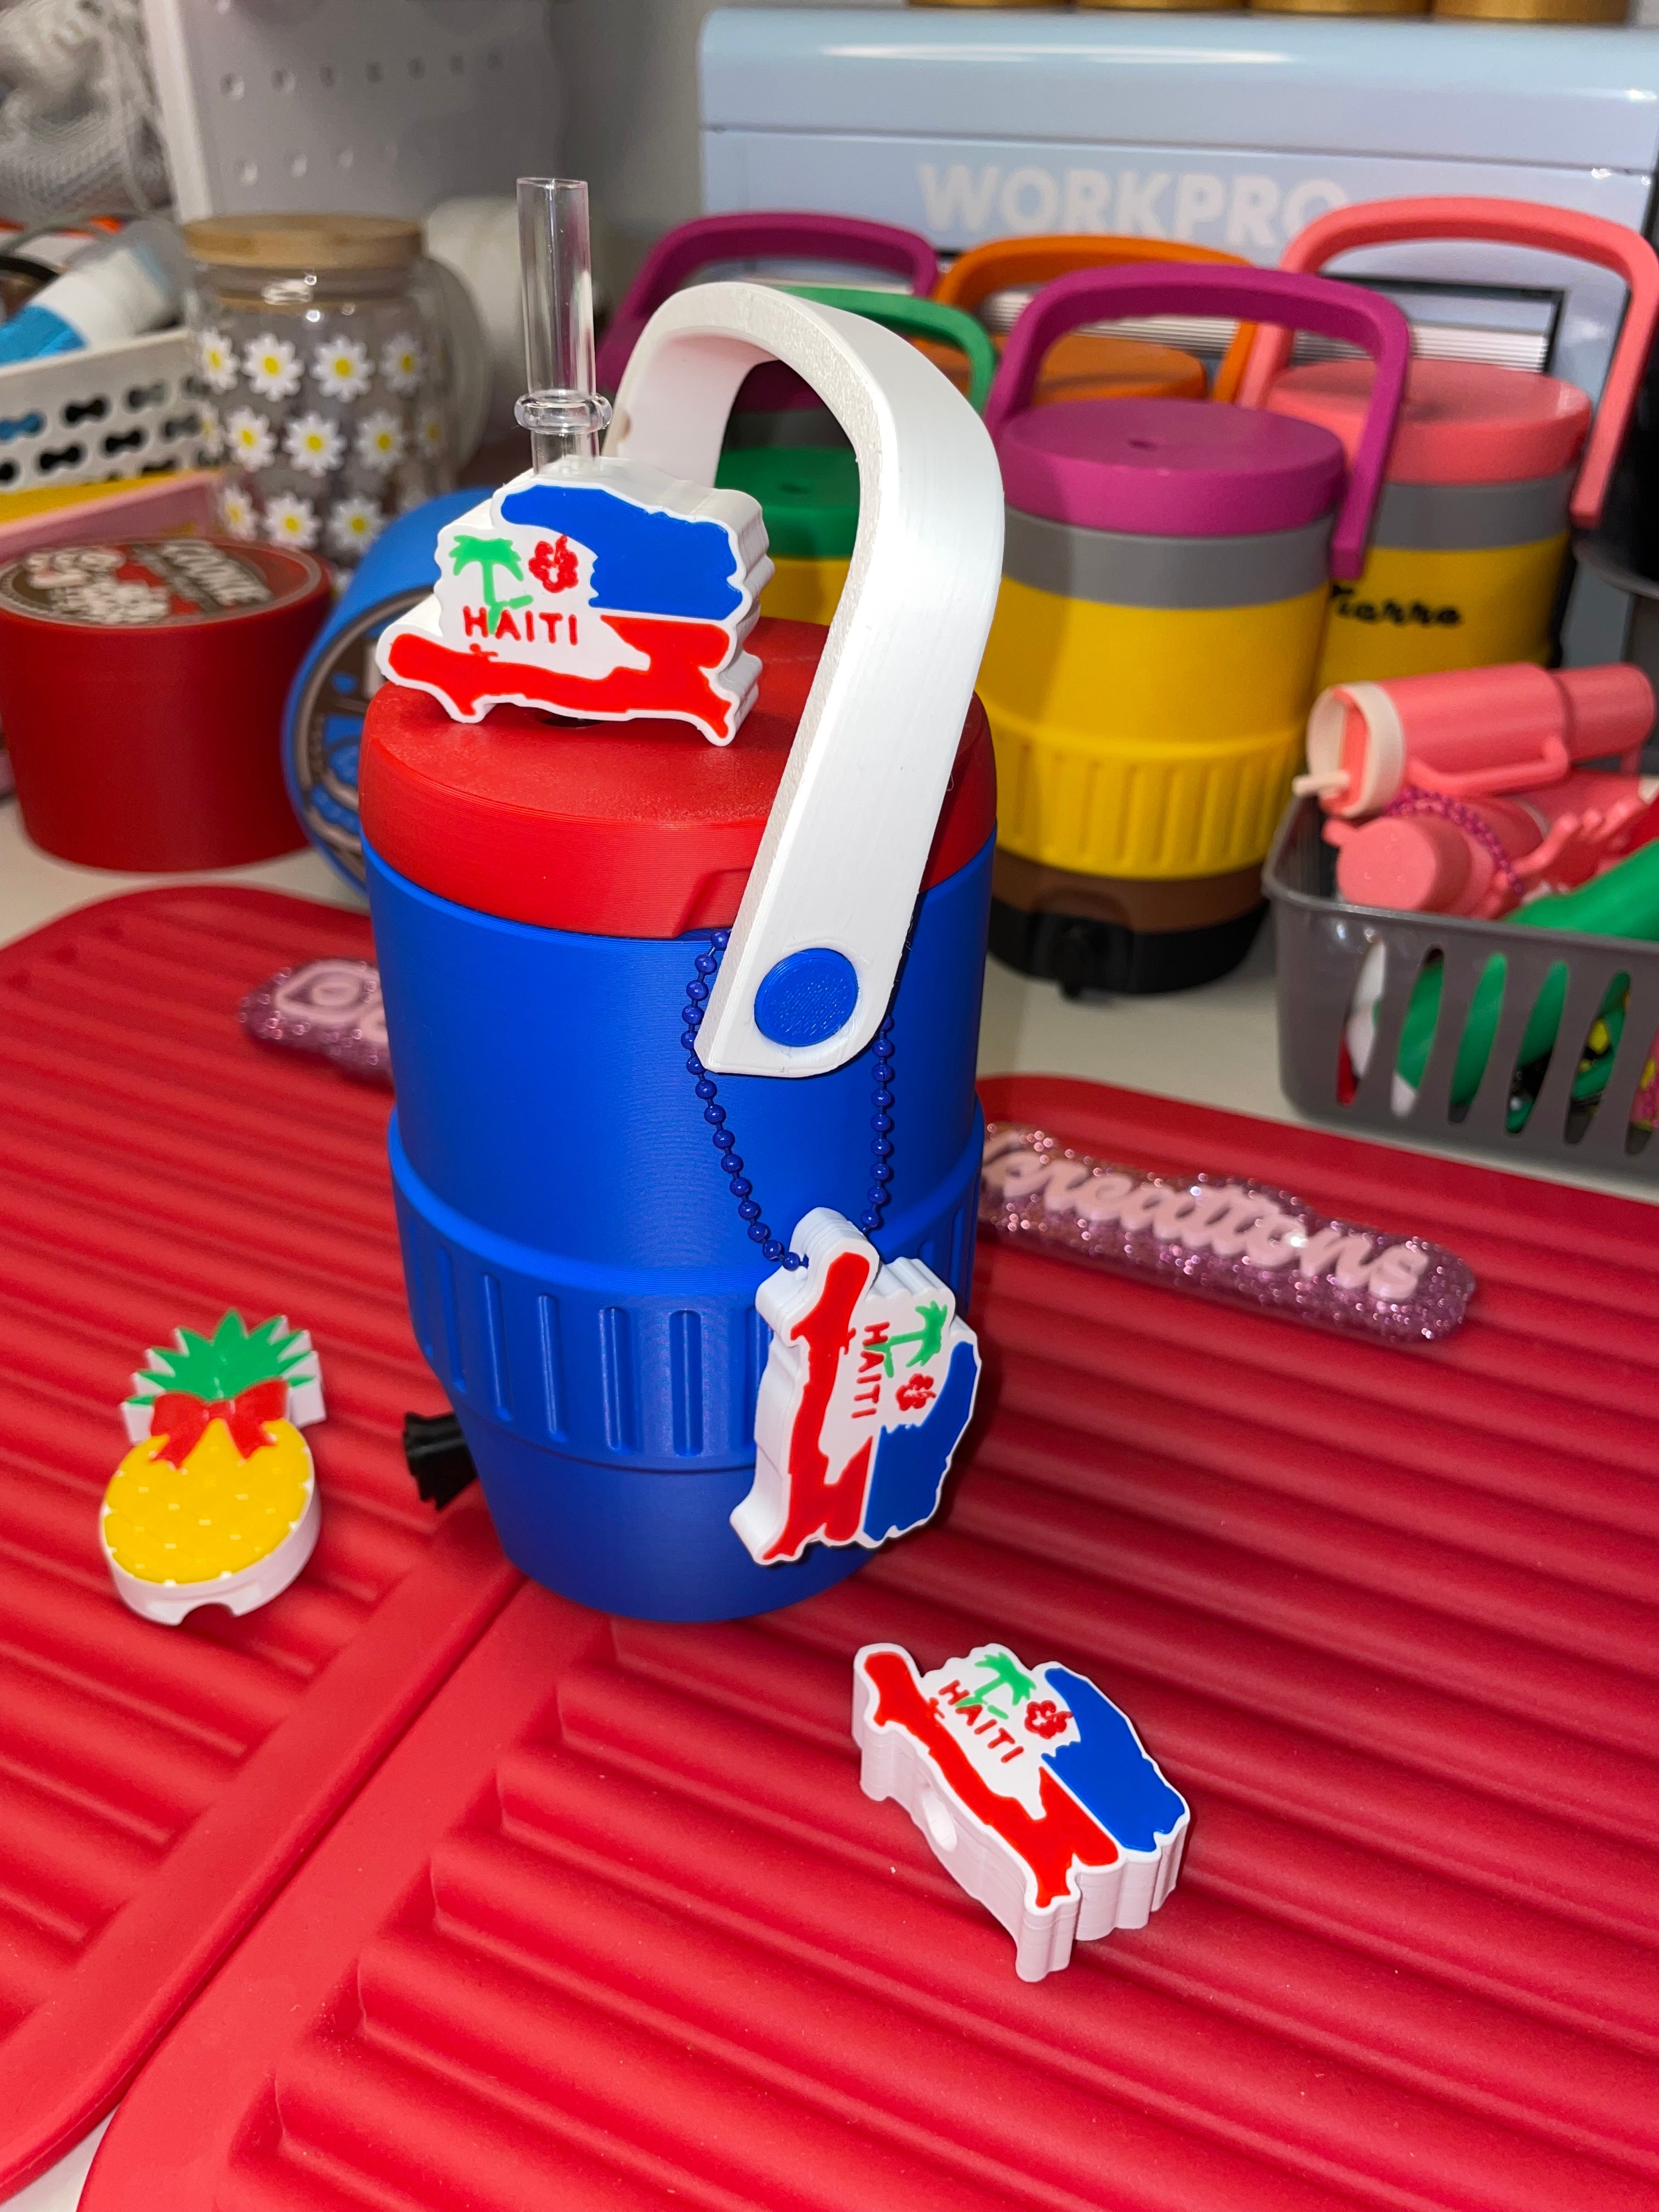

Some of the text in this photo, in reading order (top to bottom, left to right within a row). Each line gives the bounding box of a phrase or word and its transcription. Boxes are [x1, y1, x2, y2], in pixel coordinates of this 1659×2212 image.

[917, 163, 1350, 245] WORKPRO
[462, 605, 578, 646] HAITI
[851, 1321, 890, 1419] HAITI
[938, 1679, 1025, 1764] HAITI
